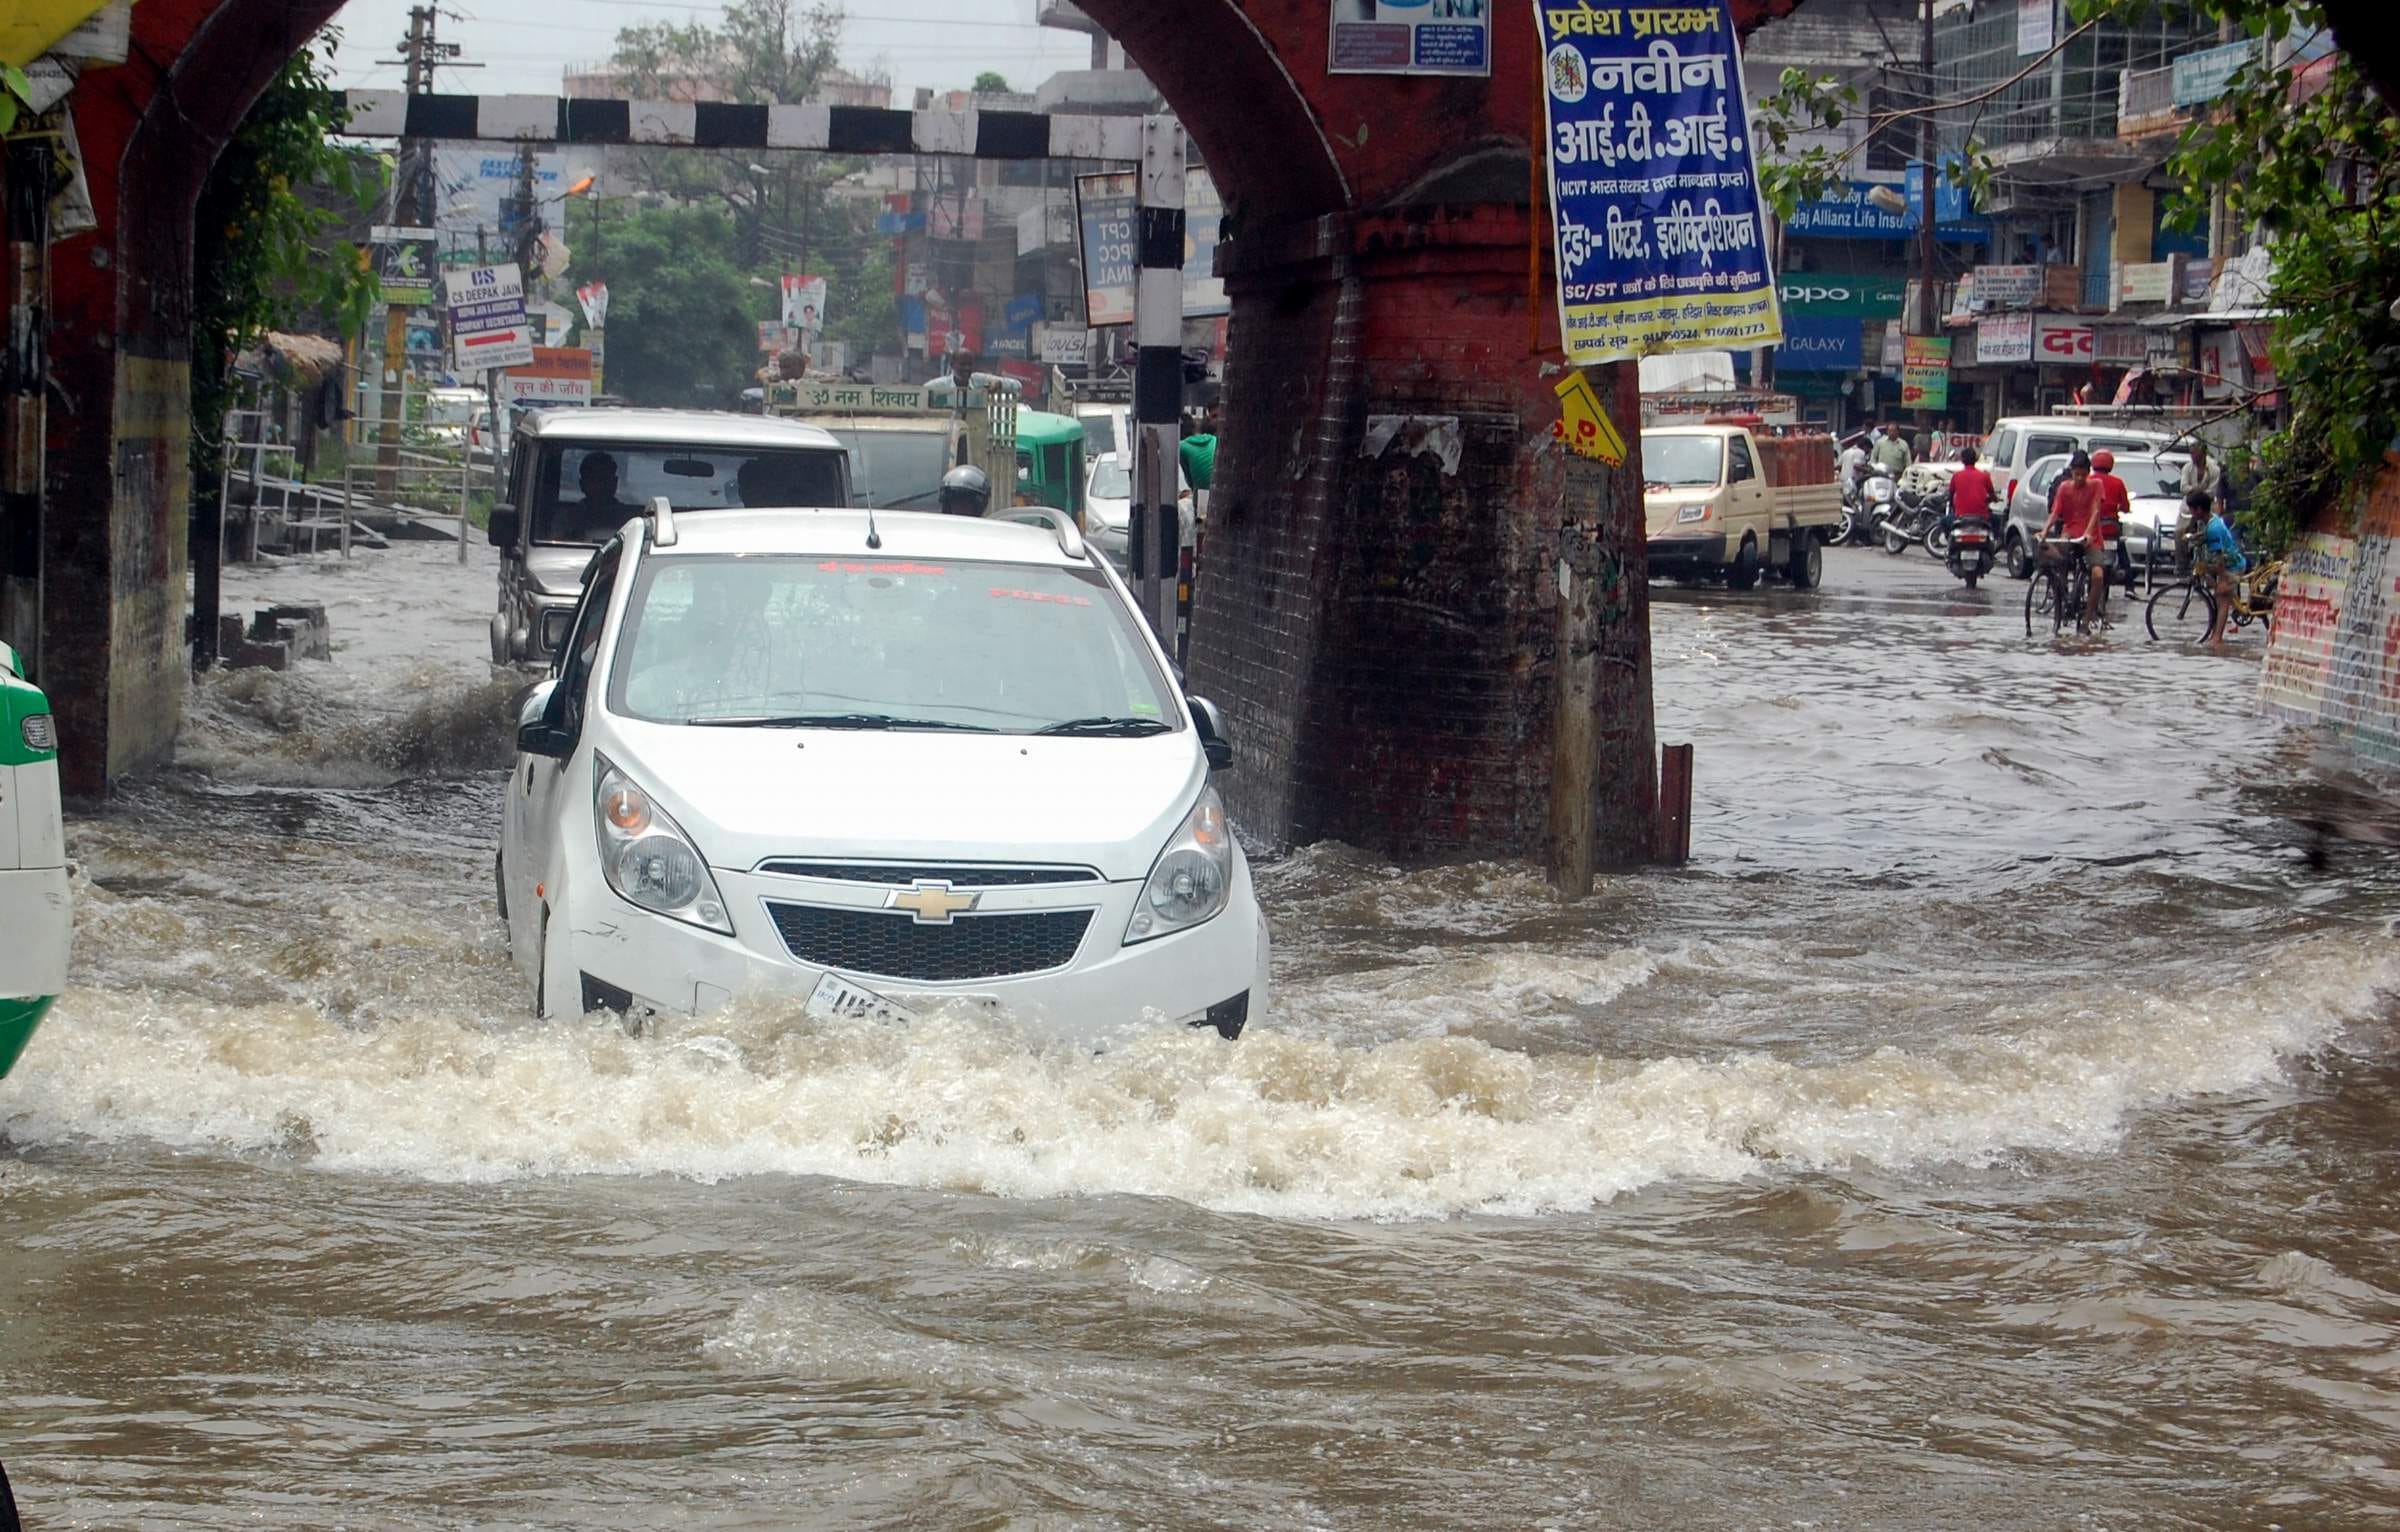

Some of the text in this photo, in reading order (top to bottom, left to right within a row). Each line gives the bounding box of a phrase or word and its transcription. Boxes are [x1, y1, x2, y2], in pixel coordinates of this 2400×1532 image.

[1547, 0, 1719, 40] प्रवेश प्रारम्भ
[1590, 40, 1727, 94] नवीन
[1591, 179, 1618, 194] भारत
[1789, 208, 1810, 229] ajaj
[1812, 209, 1852, 227] Allianz
[1854, 211, 1876, 228] Life
[466, 287, 499, 301] DEEPAK
[501, 283, 521, 296] JAIN
[1565, 282, 1617, 301] SC/ST
[1791, 336, 1845, 351] GALAXY
[871, 387, 920, 408] शिवाय
